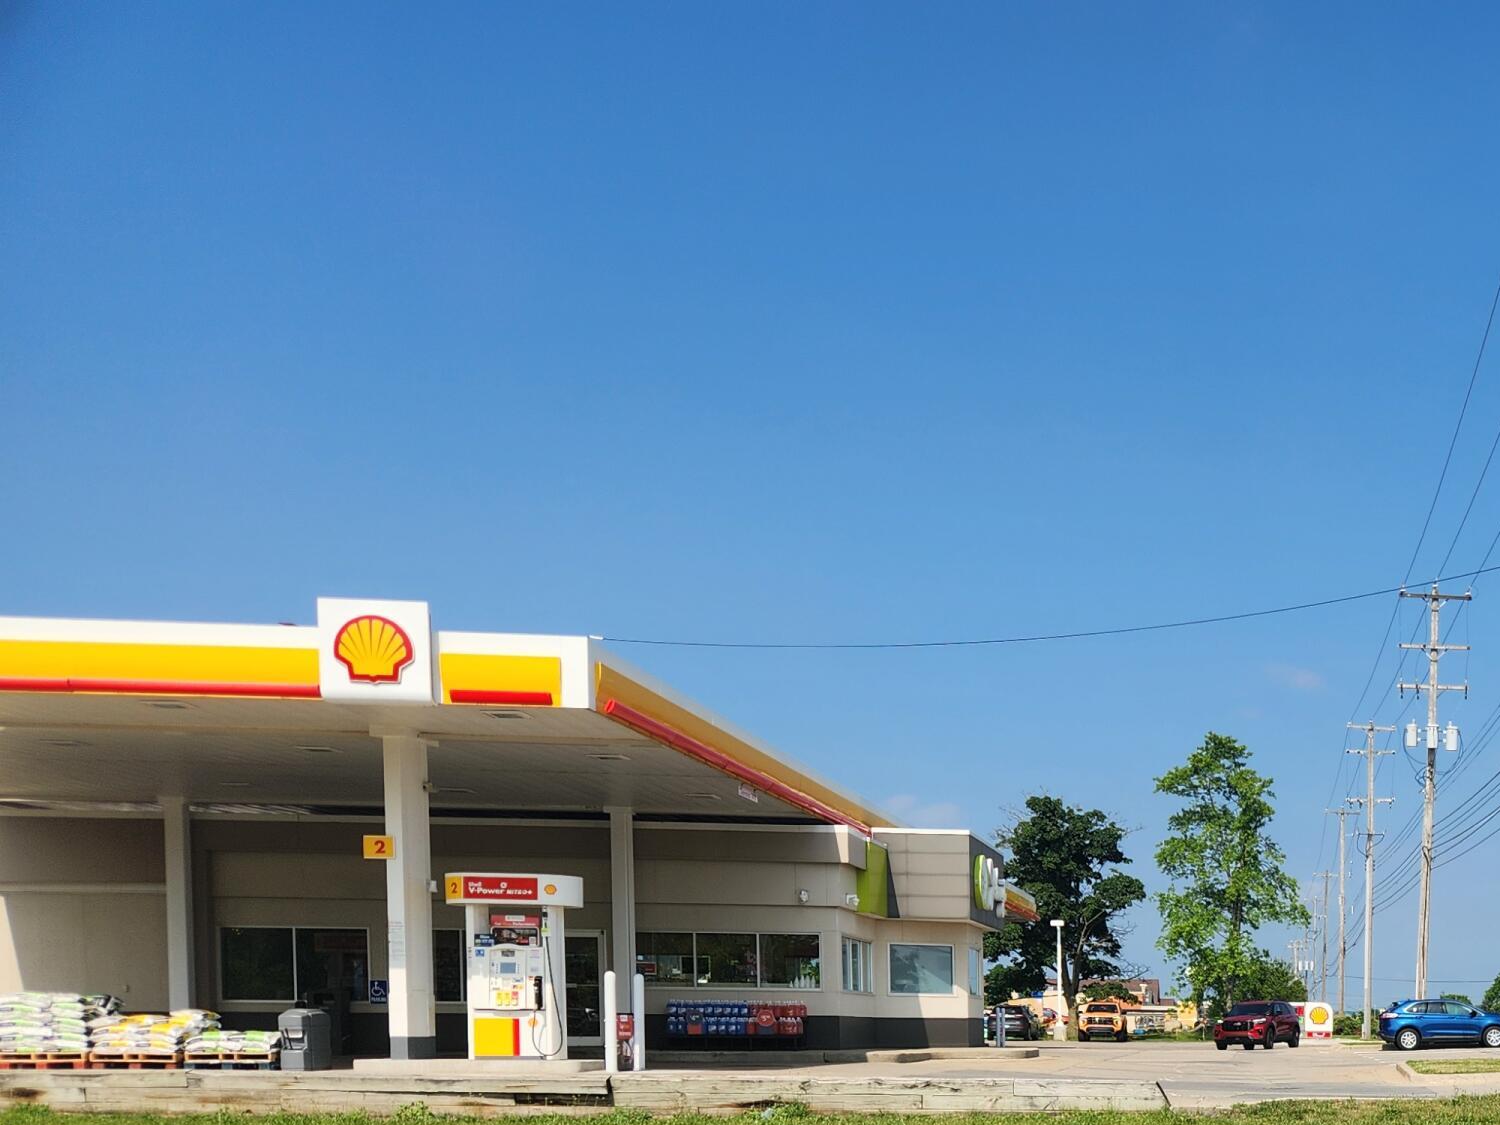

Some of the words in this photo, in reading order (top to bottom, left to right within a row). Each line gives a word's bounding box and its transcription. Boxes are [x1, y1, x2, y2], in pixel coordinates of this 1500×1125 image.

[374, 840, 386, 854] 2
[450, 882, 458, 894] 2
[468, 886, 505, 894] V-Power
